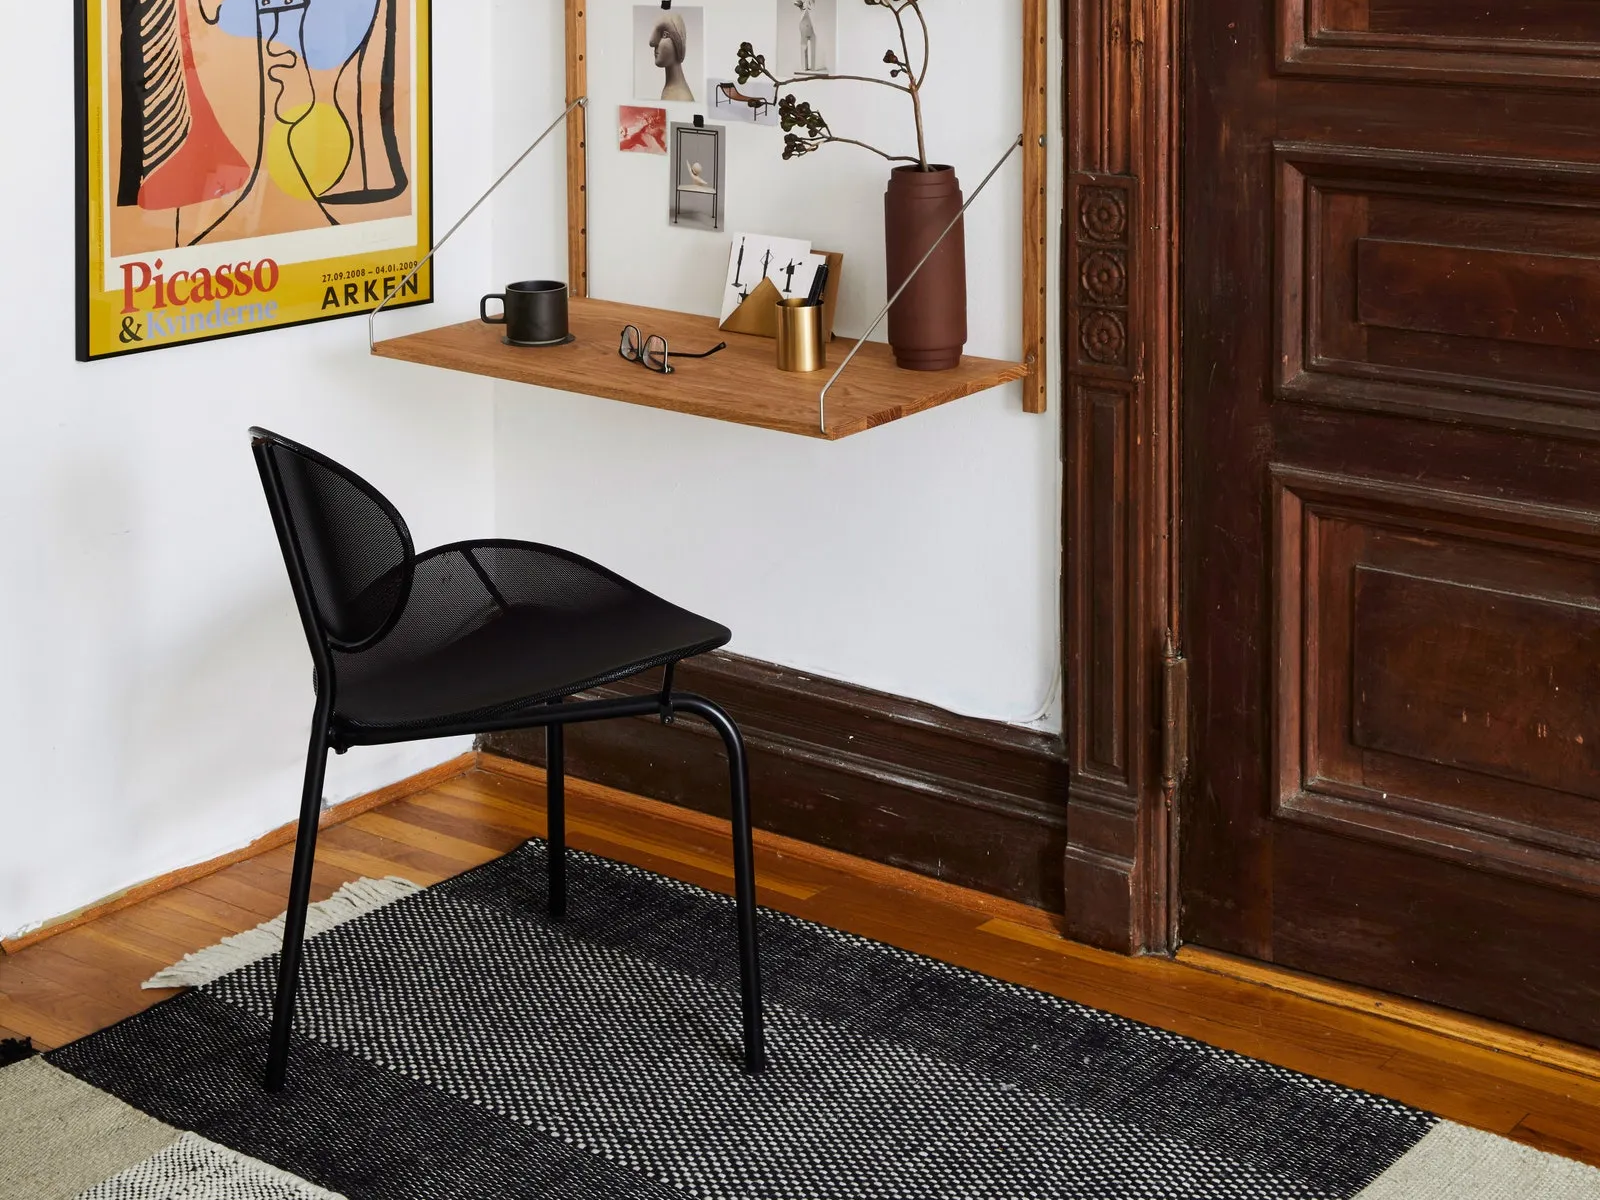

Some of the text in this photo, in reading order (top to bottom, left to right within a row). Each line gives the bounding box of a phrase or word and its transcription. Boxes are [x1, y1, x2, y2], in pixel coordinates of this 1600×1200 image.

[119, 257, 280, 314] Picasso
[321, 268, 366, 283] 27.09.2008
[375, 260, 418, 274] 04.01.2009
[321, 272, 418, 310] ARKEN
[118, 299, 279, 344] & Kvinderne
